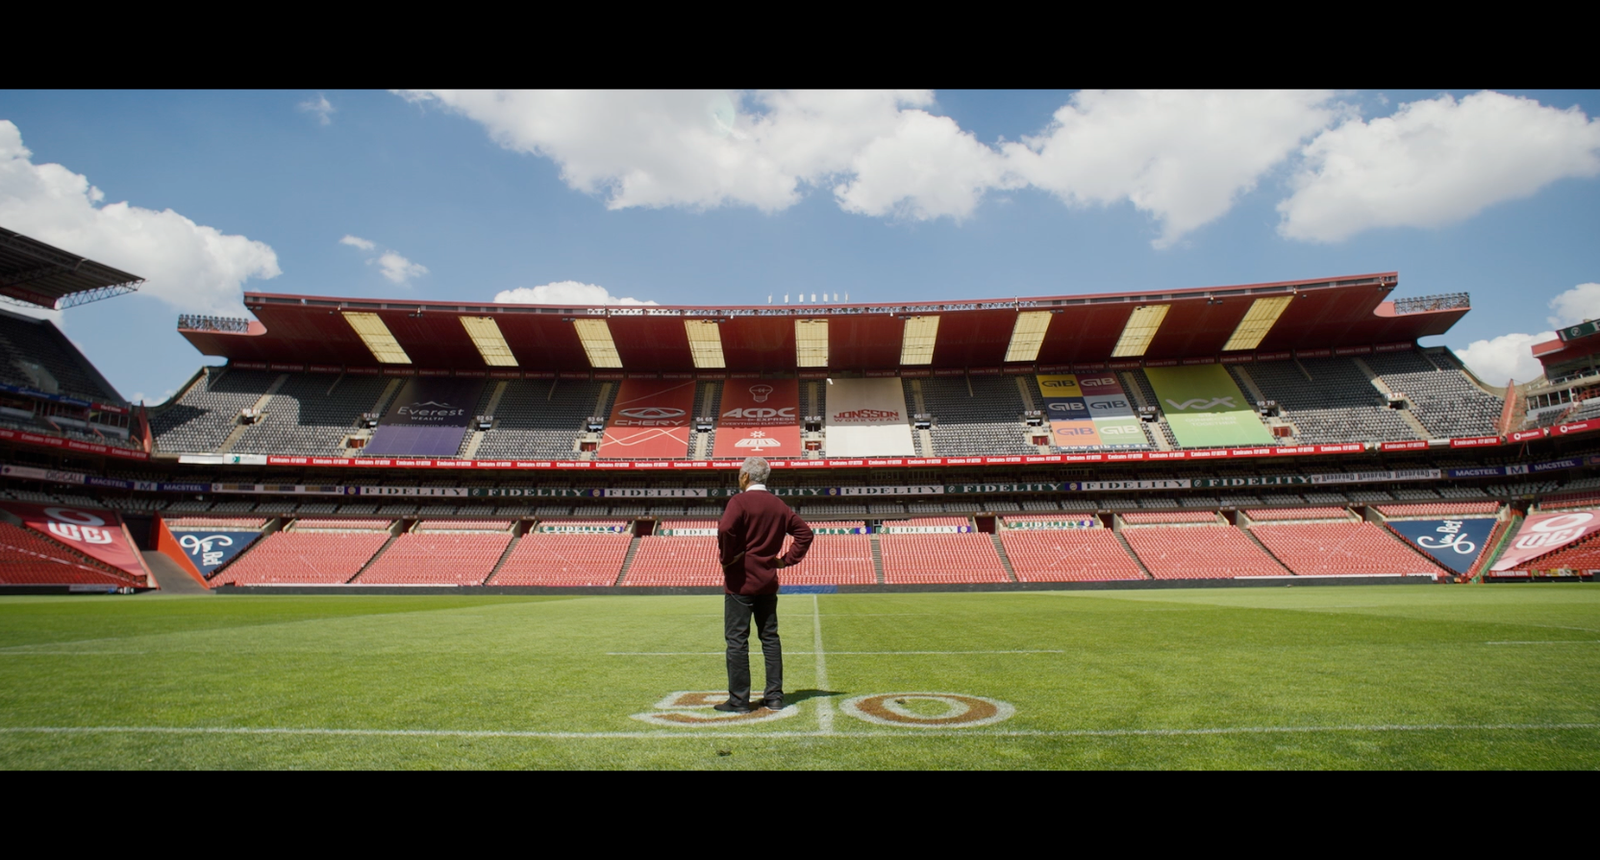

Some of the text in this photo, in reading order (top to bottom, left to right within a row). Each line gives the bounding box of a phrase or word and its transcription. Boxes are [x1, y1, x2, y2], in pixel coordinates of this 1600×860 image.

[397, 406, 464, 416] Everest
[833, 409, 900, 418] JONSSON
[1534, 461, 1575, 470] MACSTEEL
[90, 478, 128, 488] MACSTEEL
[1087, 481, 1186, 489] FIDELITY
[1208, 476, 1311, 486] FIDELITY
[963, 484, 1060, 492] FIDELITY
